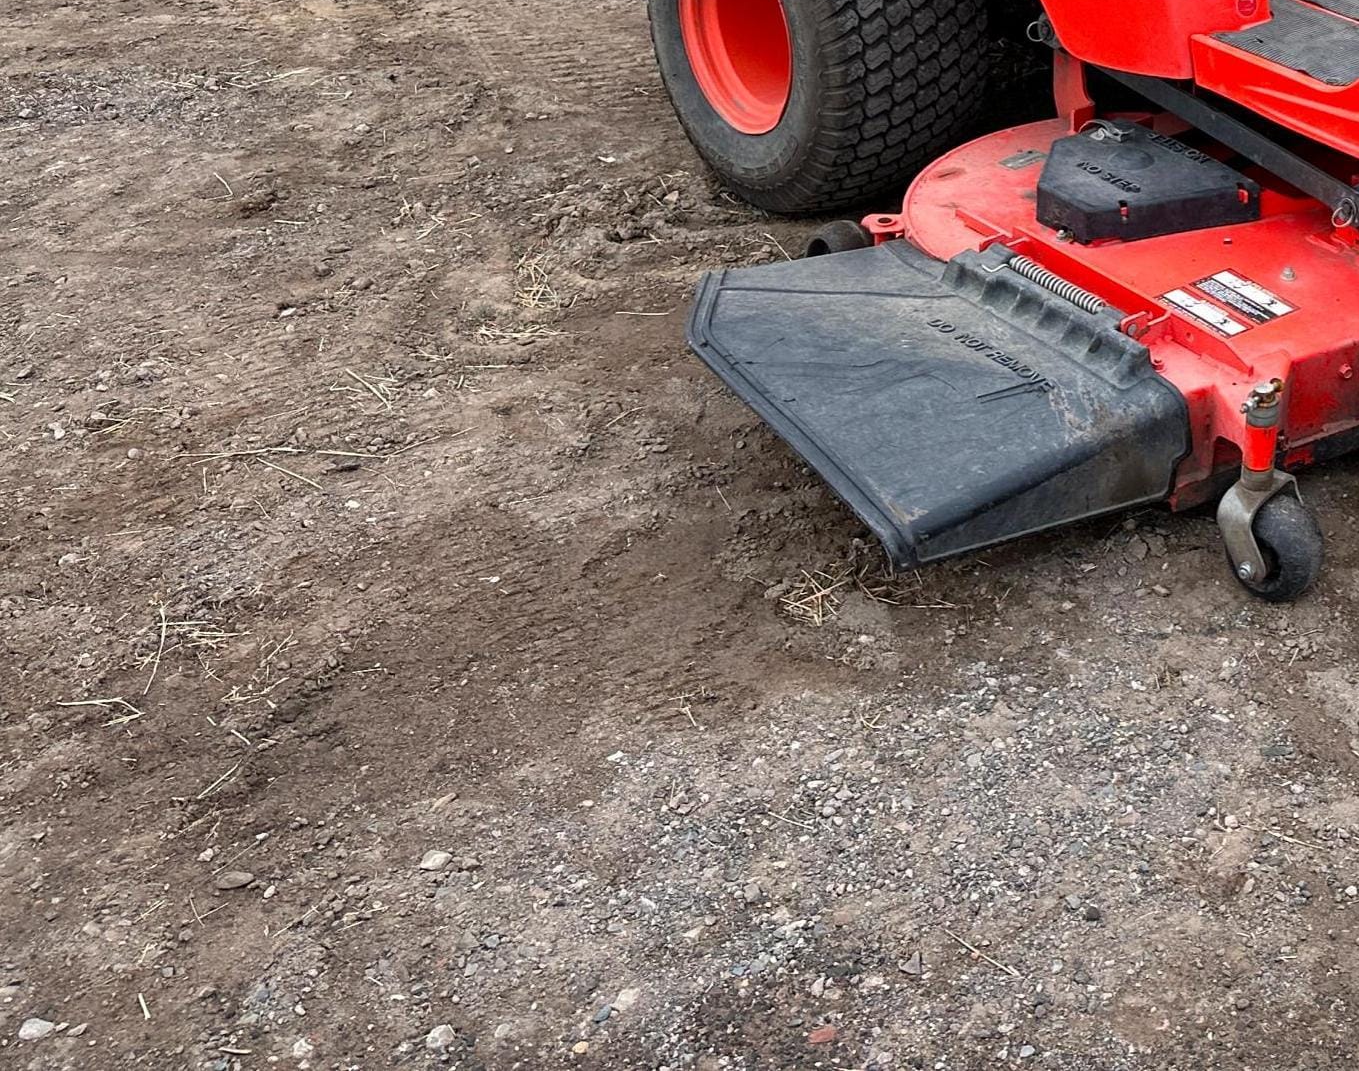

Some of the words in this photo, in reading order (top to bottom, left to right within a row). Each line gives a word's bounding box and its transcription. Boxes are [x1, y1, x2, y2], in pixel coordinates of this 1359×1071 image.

[1077, 161, 1102, 175] NO
[1101, 172, 1142, 193] STEP
[927, 318, 956, 333] DO
[954, 333, 993, 352] NOT
[985, 351, 1056, 394] REMOVE
